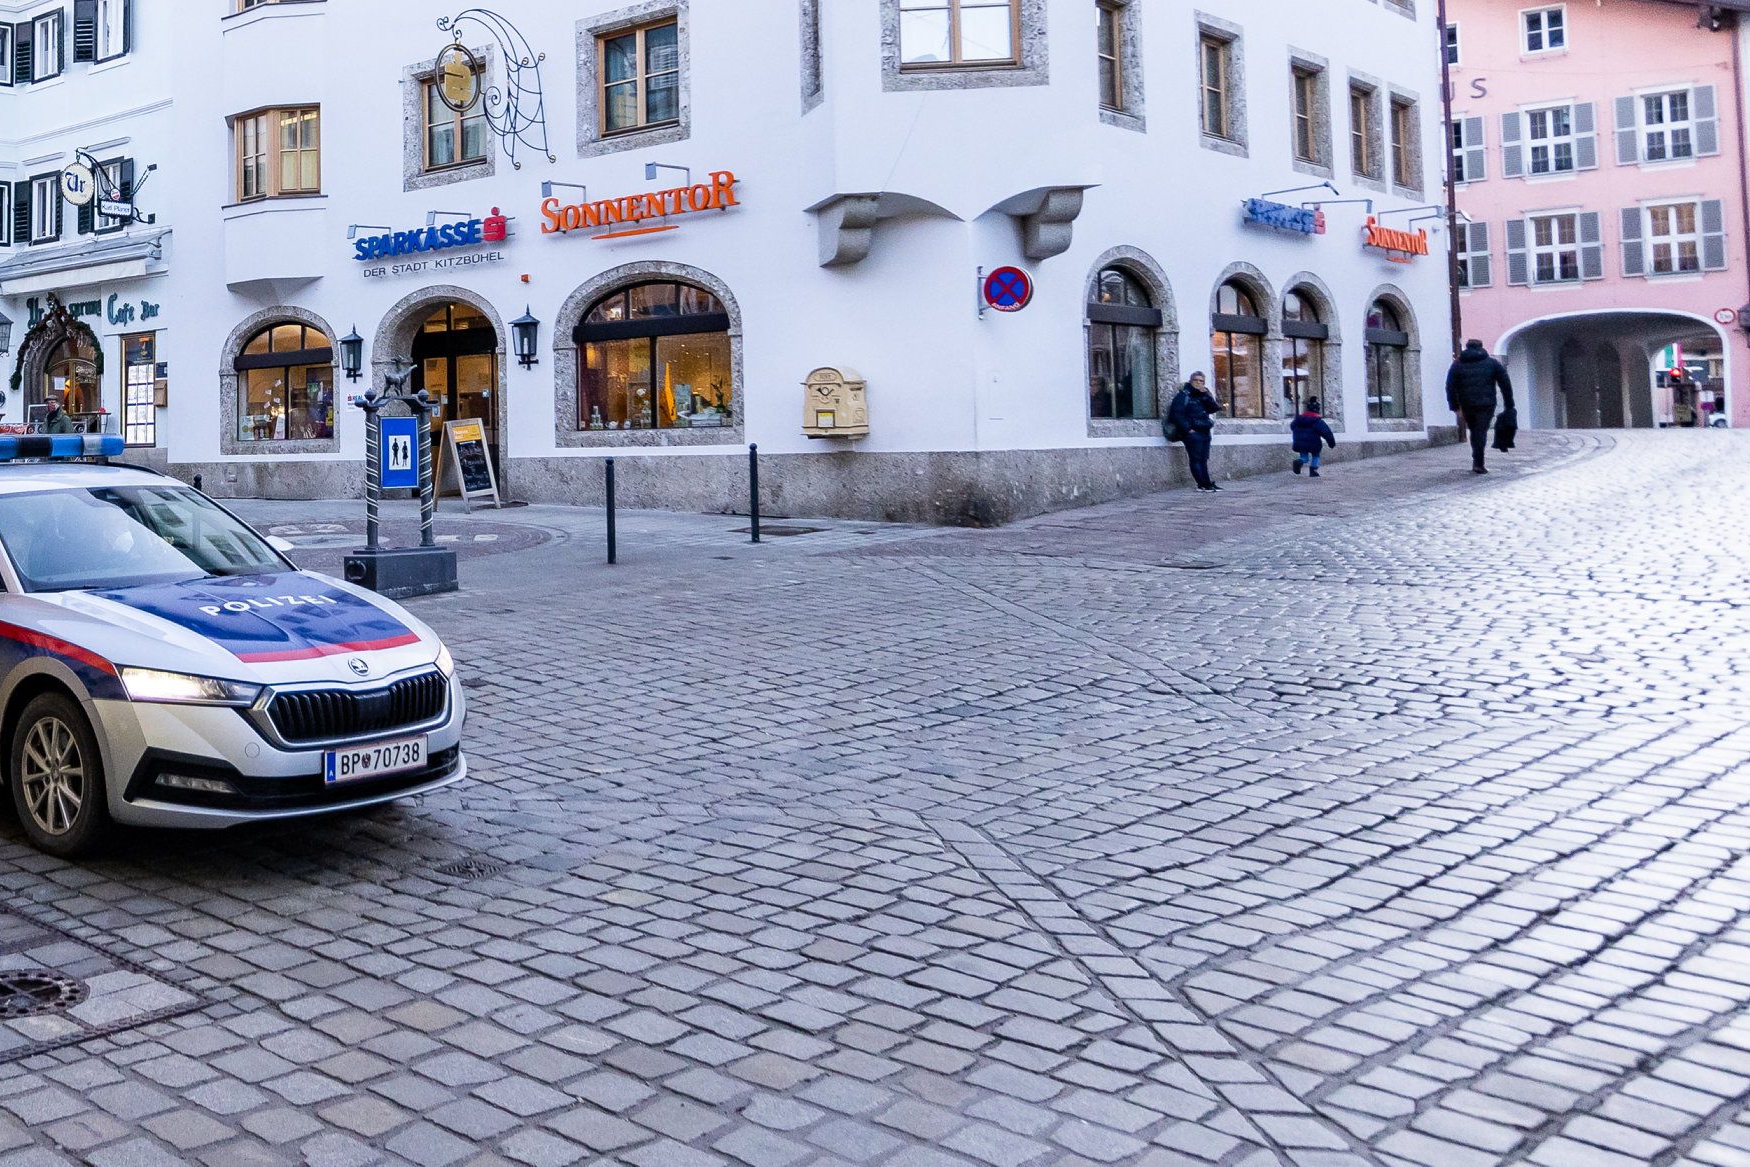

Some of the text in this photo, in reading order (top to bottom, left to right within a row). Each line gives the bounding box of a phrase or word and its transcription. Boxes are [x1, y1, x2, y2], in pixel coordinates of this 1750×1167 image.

[540, 170, 740, 234] SONNENTOR
[353, 218, 482, 261] SPARKASSE
[363, 252, 505, 278] DER STADT KITZBÜHEL
[199, 594, 338, 617] POLIZEI
[341, 742, 420, 775] BP 70738
